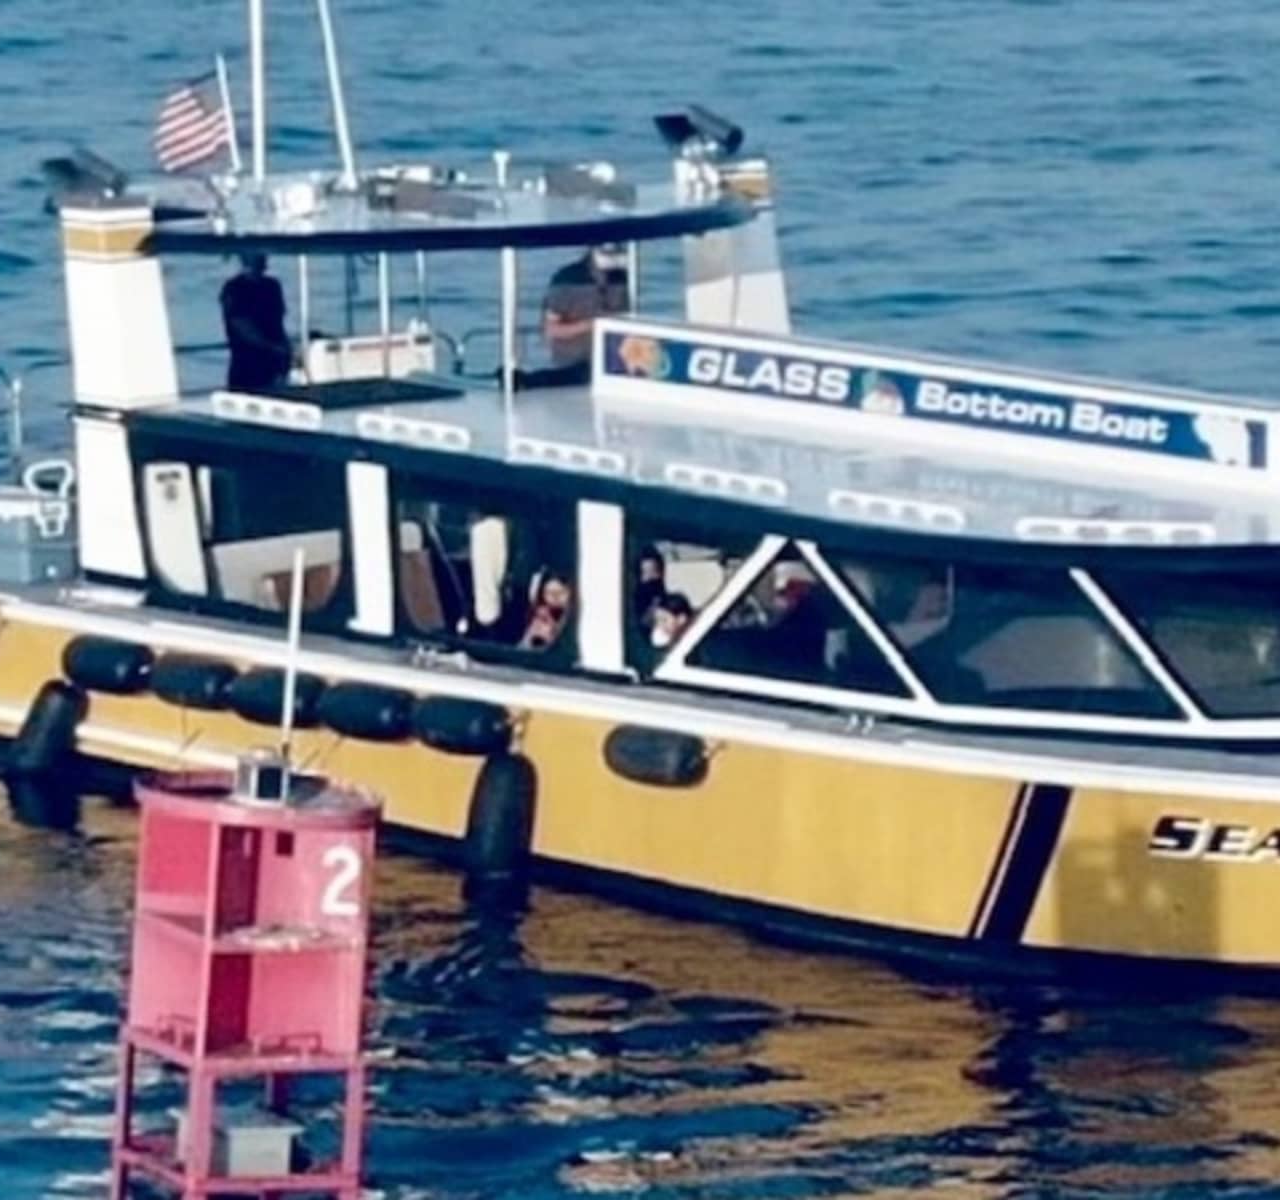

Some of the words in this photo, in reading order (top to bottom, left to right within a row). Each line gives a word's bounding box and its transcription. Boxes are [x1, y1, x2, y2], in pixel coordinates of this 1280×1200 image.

[688, 350, 848, 401] GLASS
[917, 381, 1065, 429] Bottom
[1072, 404, 1168, 442] Boat
[322, 846, 360, 915] 2
